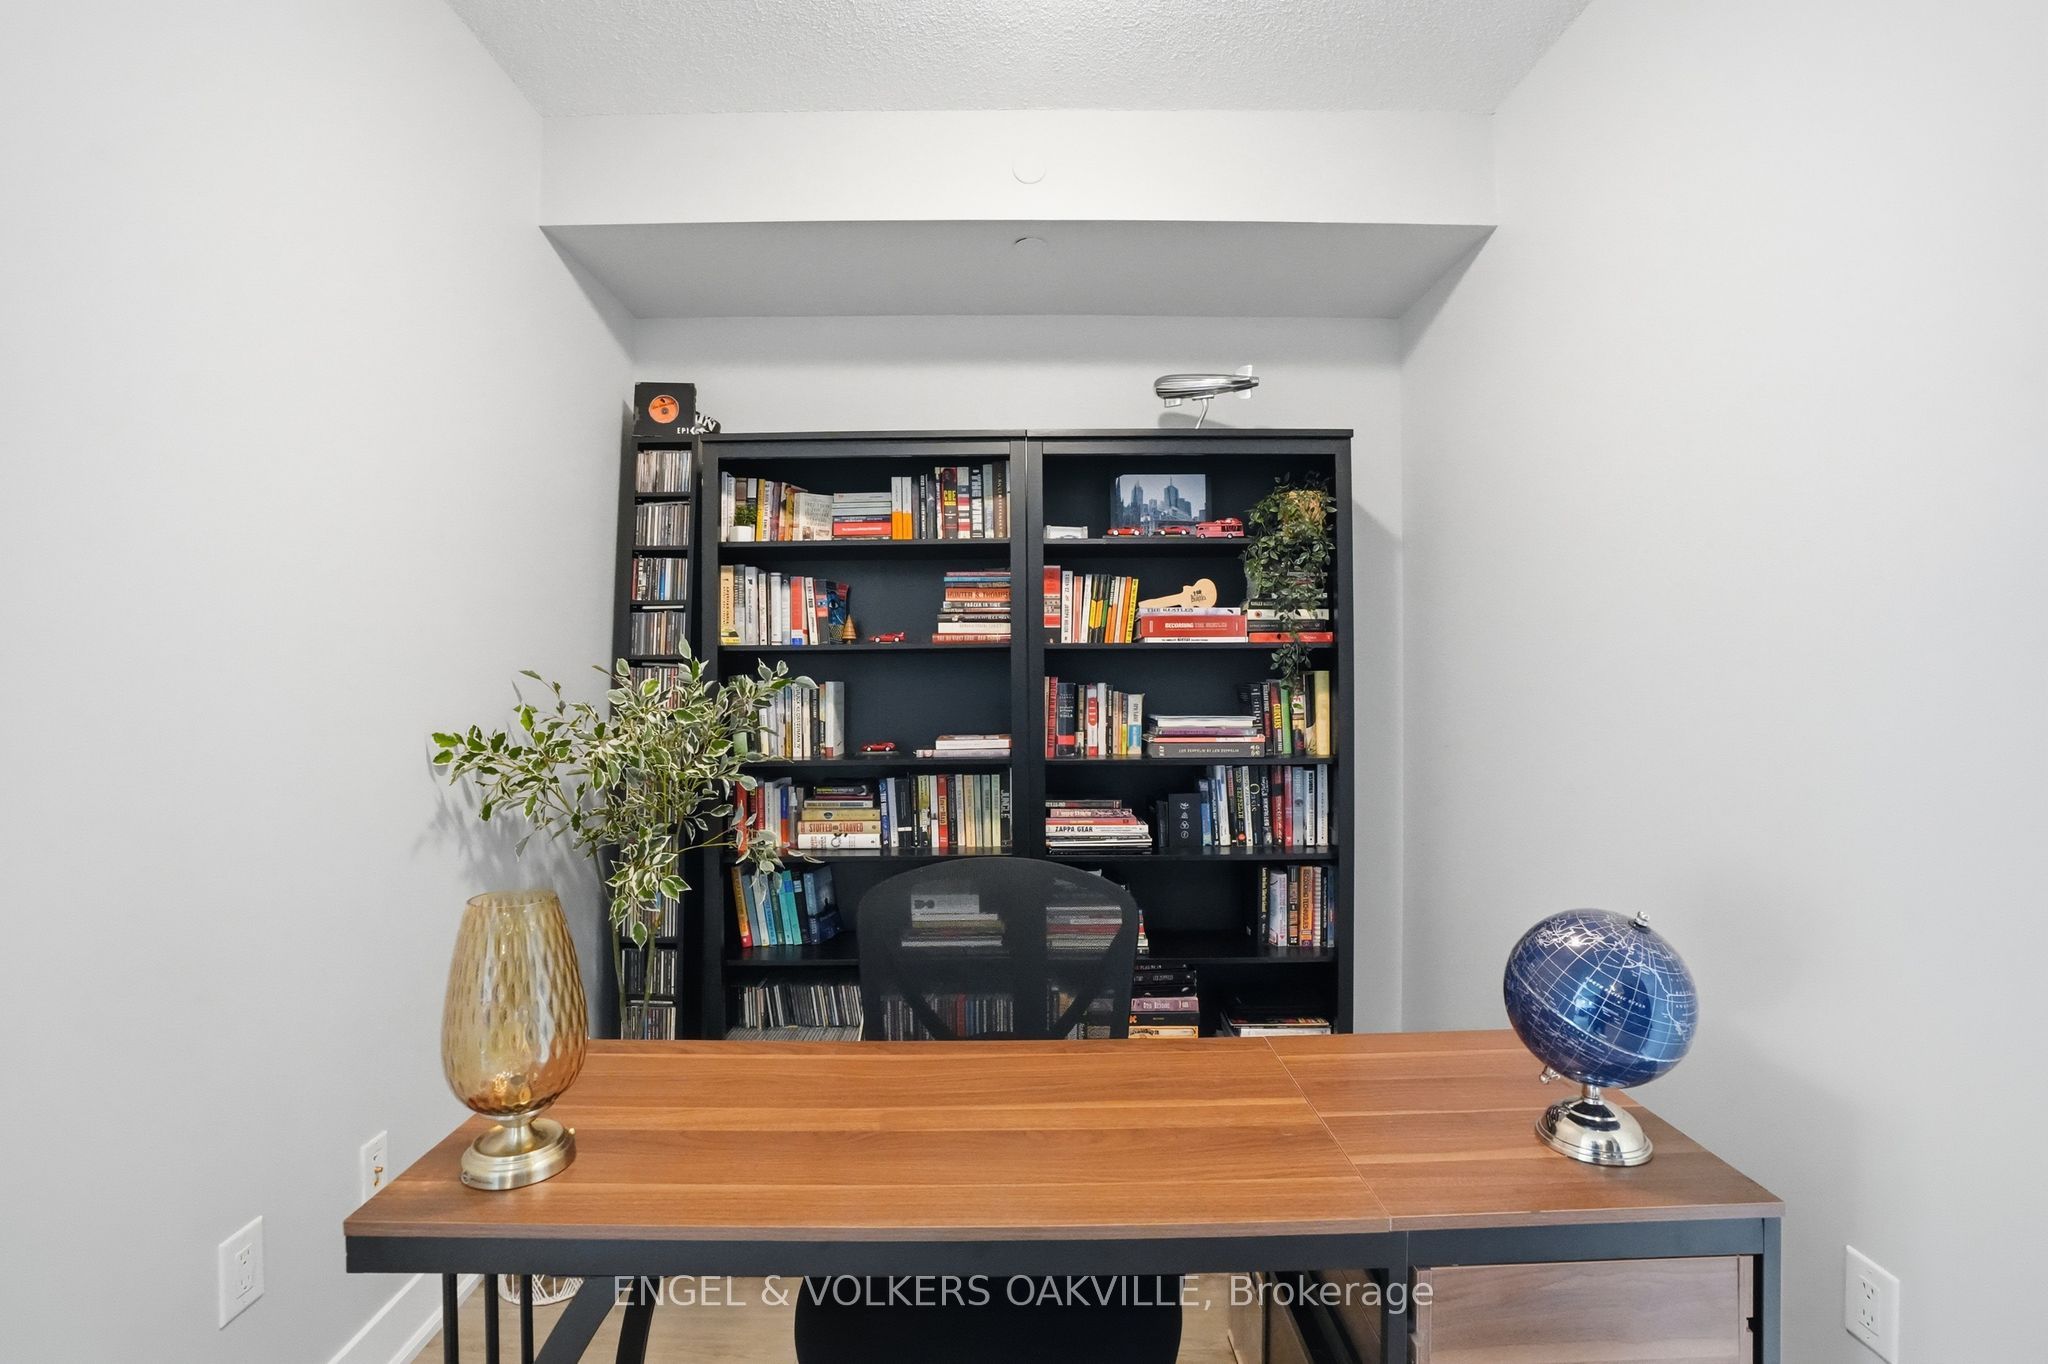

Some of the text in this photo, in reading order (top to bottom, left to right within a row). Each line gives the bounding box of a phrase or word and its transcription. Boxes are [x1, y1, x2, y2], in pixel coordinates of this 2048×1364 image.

[971, 498, 982, 531] WIRE
[808, 822, 864, 833] STUFFED STARVED
